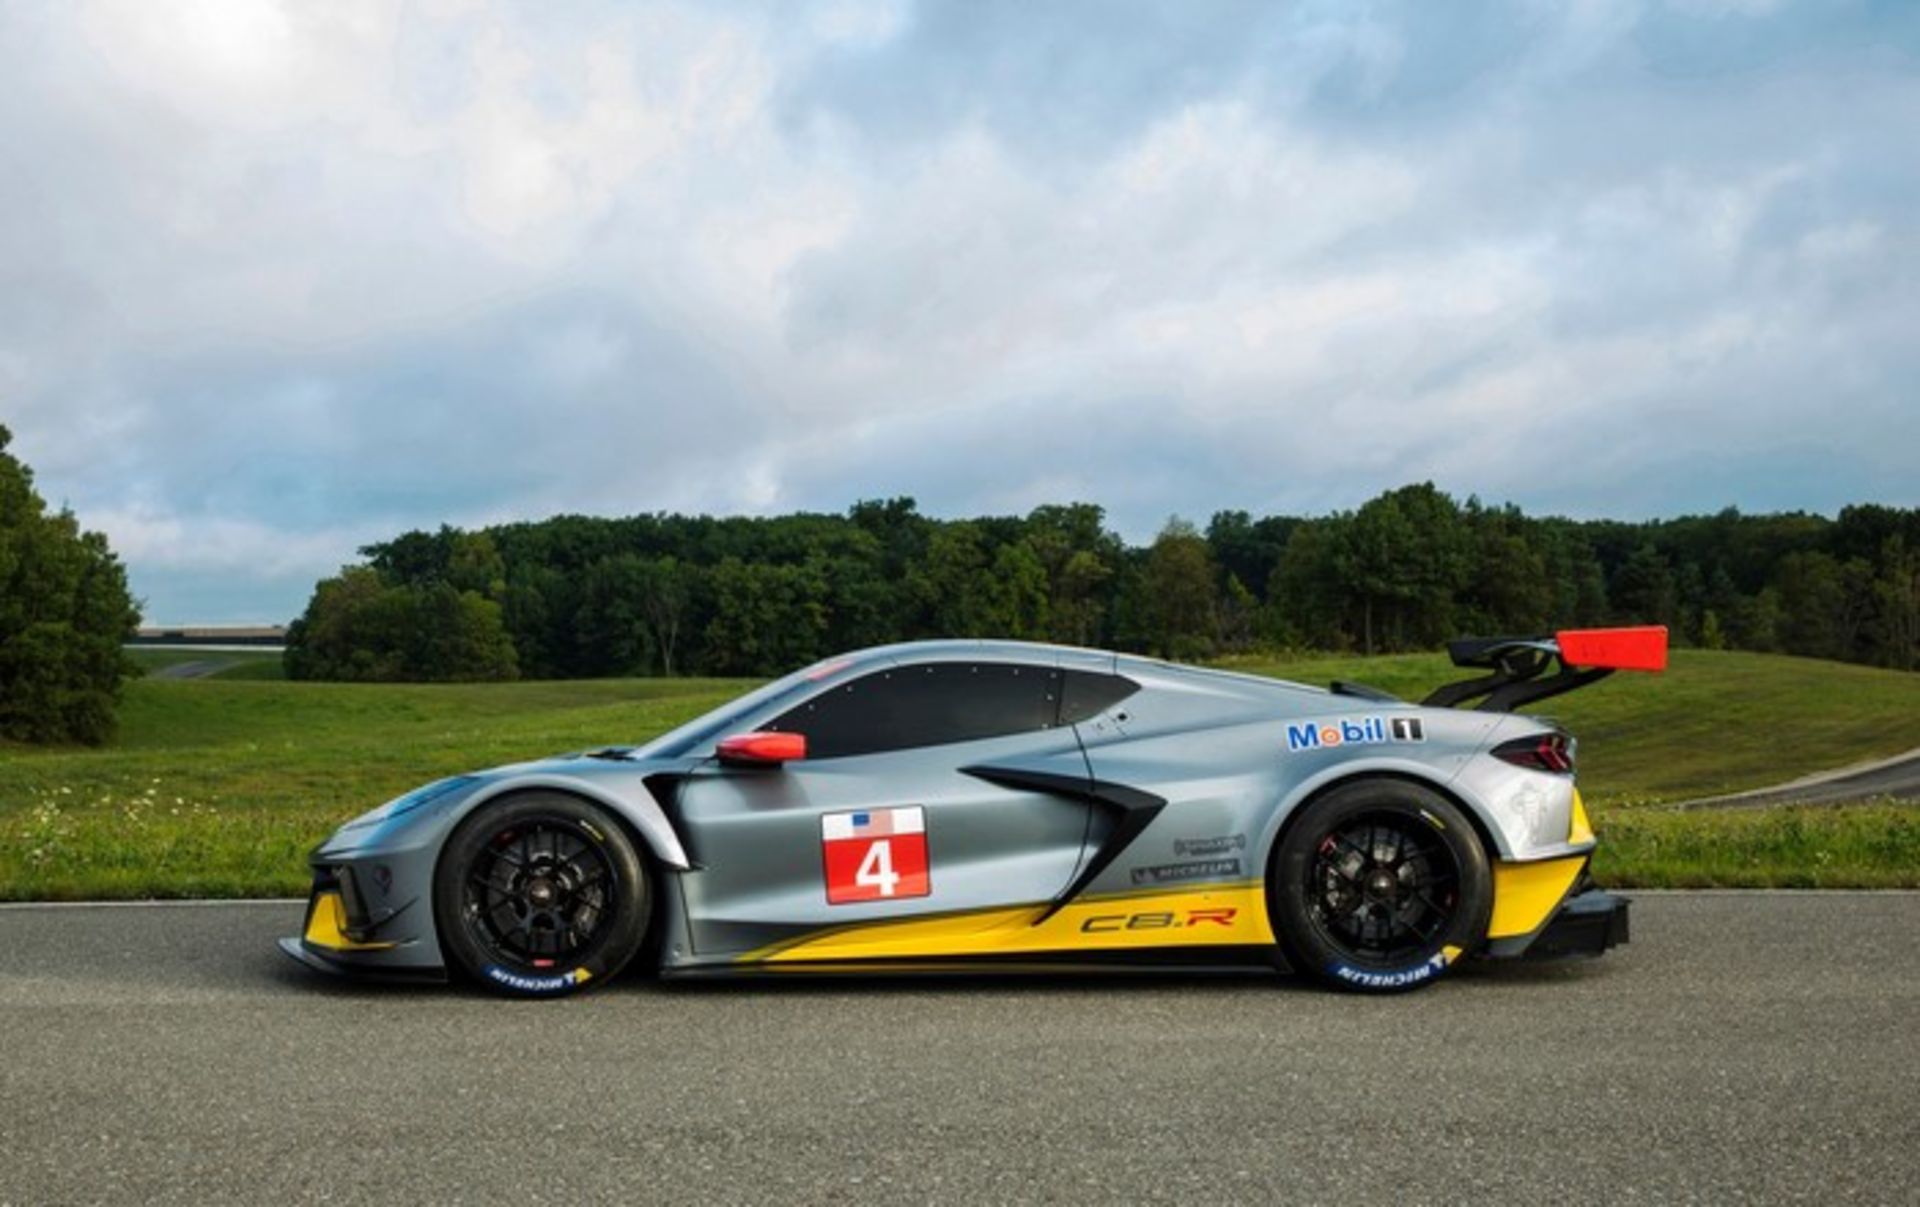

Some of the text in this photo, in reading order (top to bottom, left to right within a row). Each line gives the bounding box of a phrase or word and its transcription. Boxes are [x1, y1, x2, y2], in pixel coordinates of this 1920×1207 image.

[1288, 718, 1383, 749] Mobil
[855, 839, 900, 896] 4
[1160, 862, 1232, 879] MICHELIN
[1081, 908, 1237, 933] C8.R
[490, 967, 563, 991] MICHELIN
[1338, 964, 1431, 986] MICHELIN
